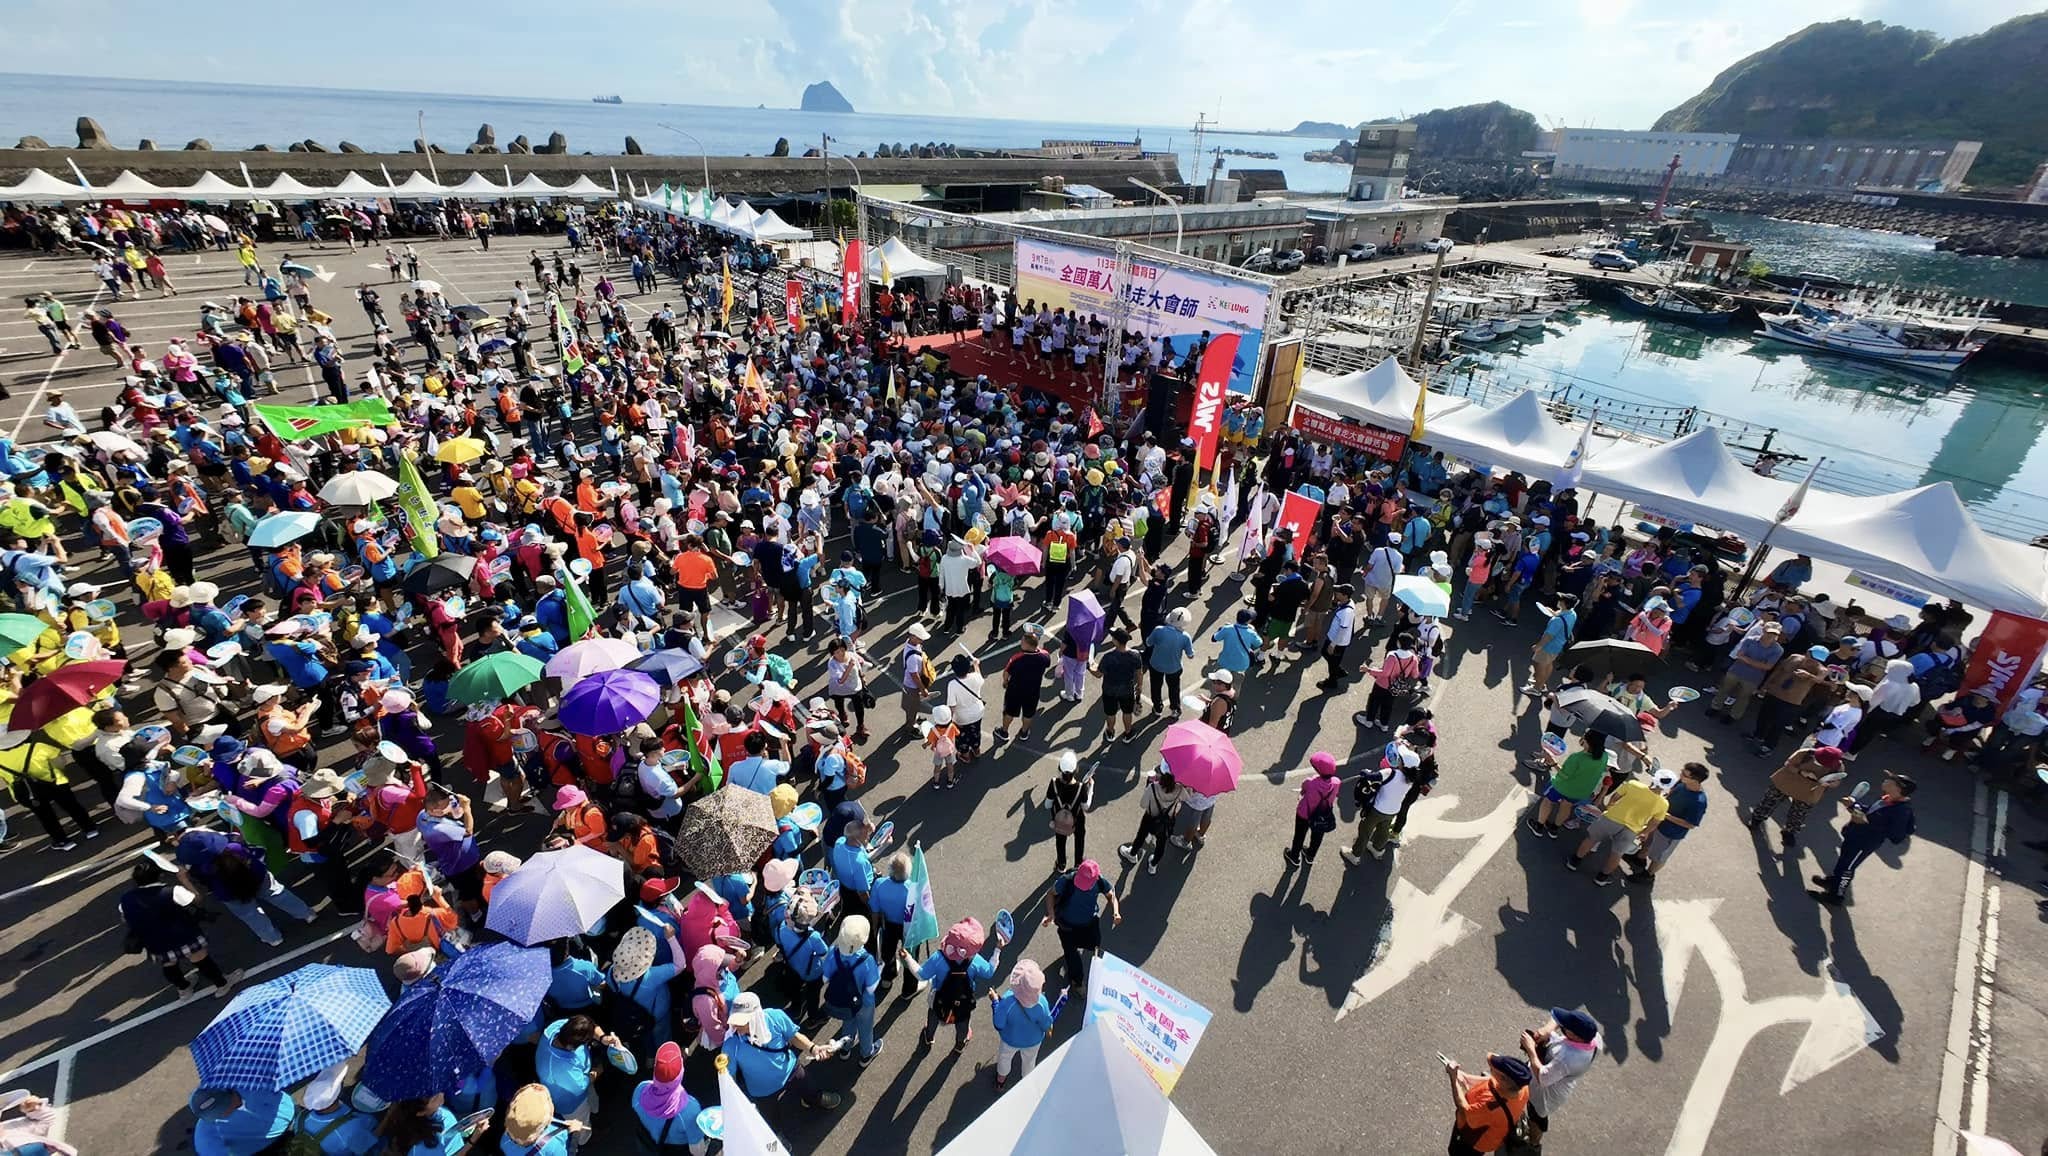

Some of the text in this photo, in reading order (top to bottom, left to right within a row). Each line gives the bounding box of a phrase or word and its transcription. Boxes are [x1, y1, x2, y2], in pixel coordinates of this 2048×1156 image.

[1097, 257, 1157, 281] 113年體育日
[1219, 300, 1249, 314] KEELUNG
